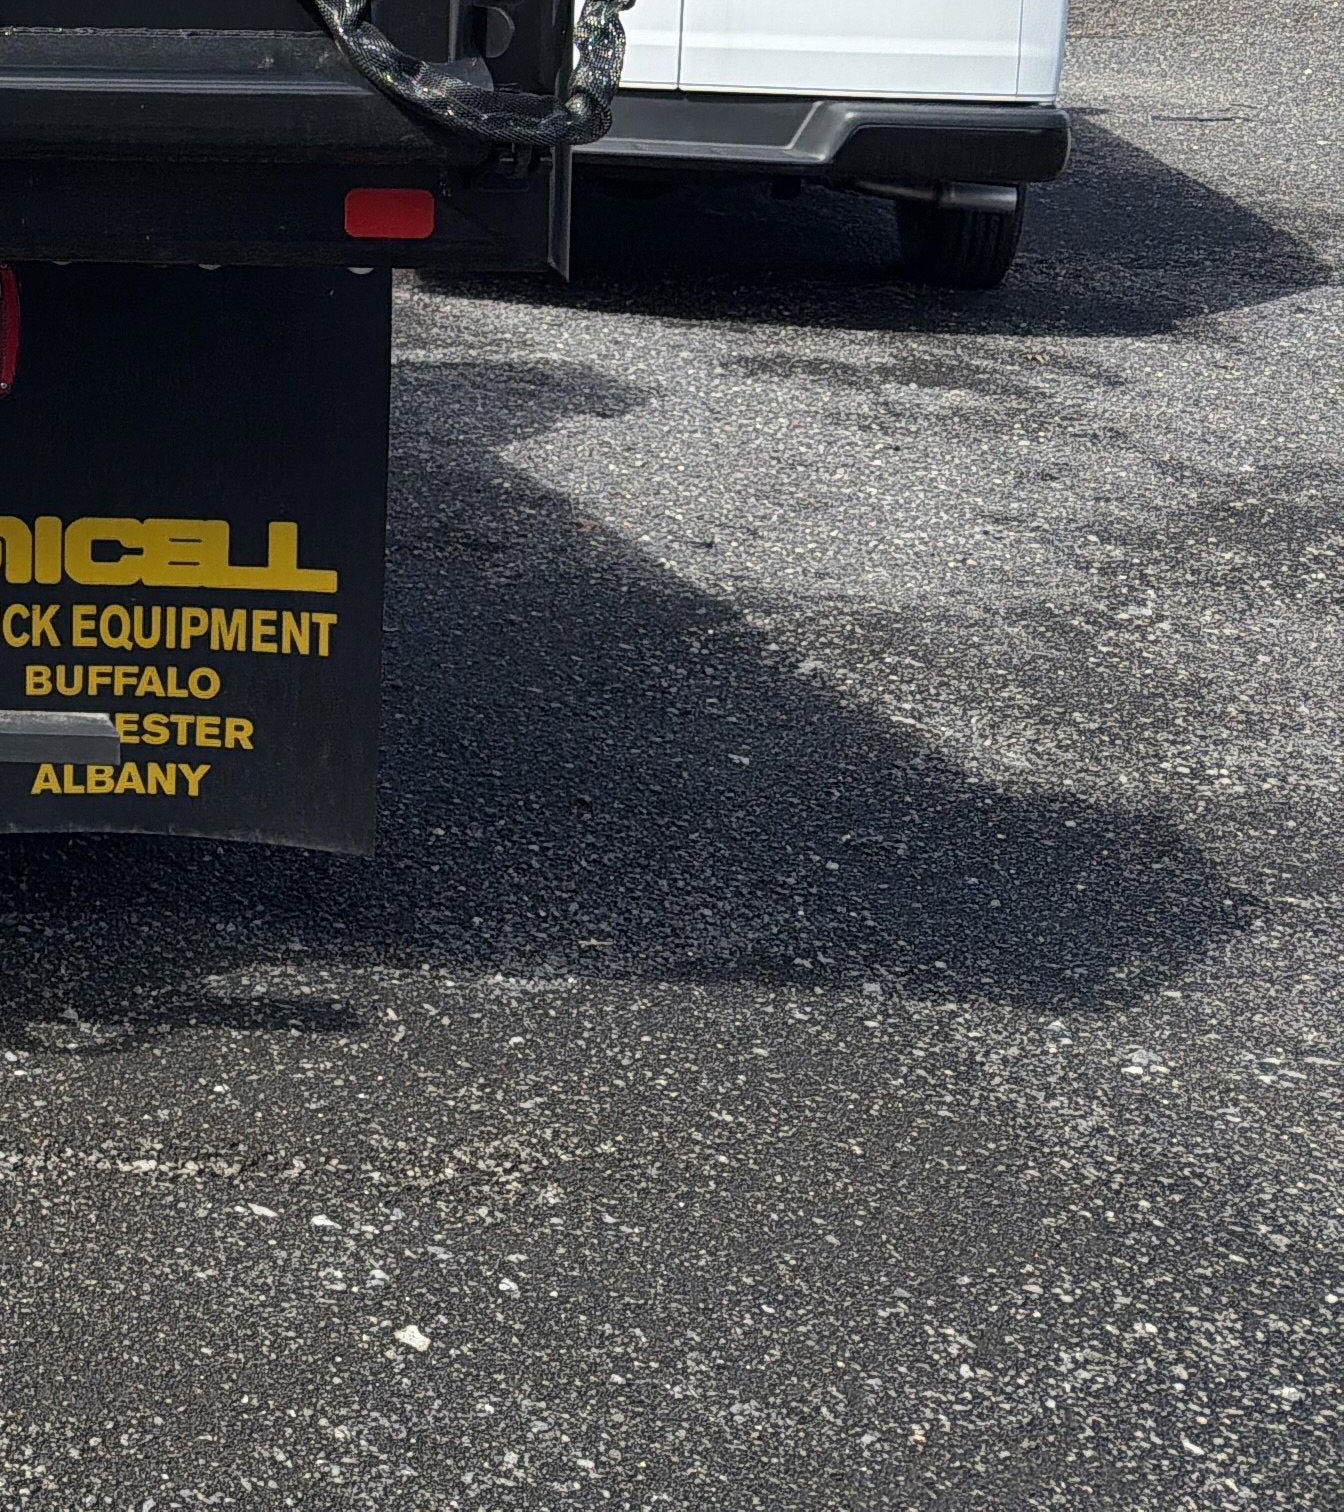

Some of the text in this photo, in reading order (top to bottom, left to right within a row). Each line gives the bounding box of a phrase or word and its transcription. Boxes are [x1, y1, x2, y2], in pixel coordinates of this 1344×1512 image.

[71, 604, 338, 657] EQUIPMENT
[24, 664, 221, 700] BUFFALO
[114, 713, 254, 750] ESTER
[30, 762, 211, 797] ALBANY
